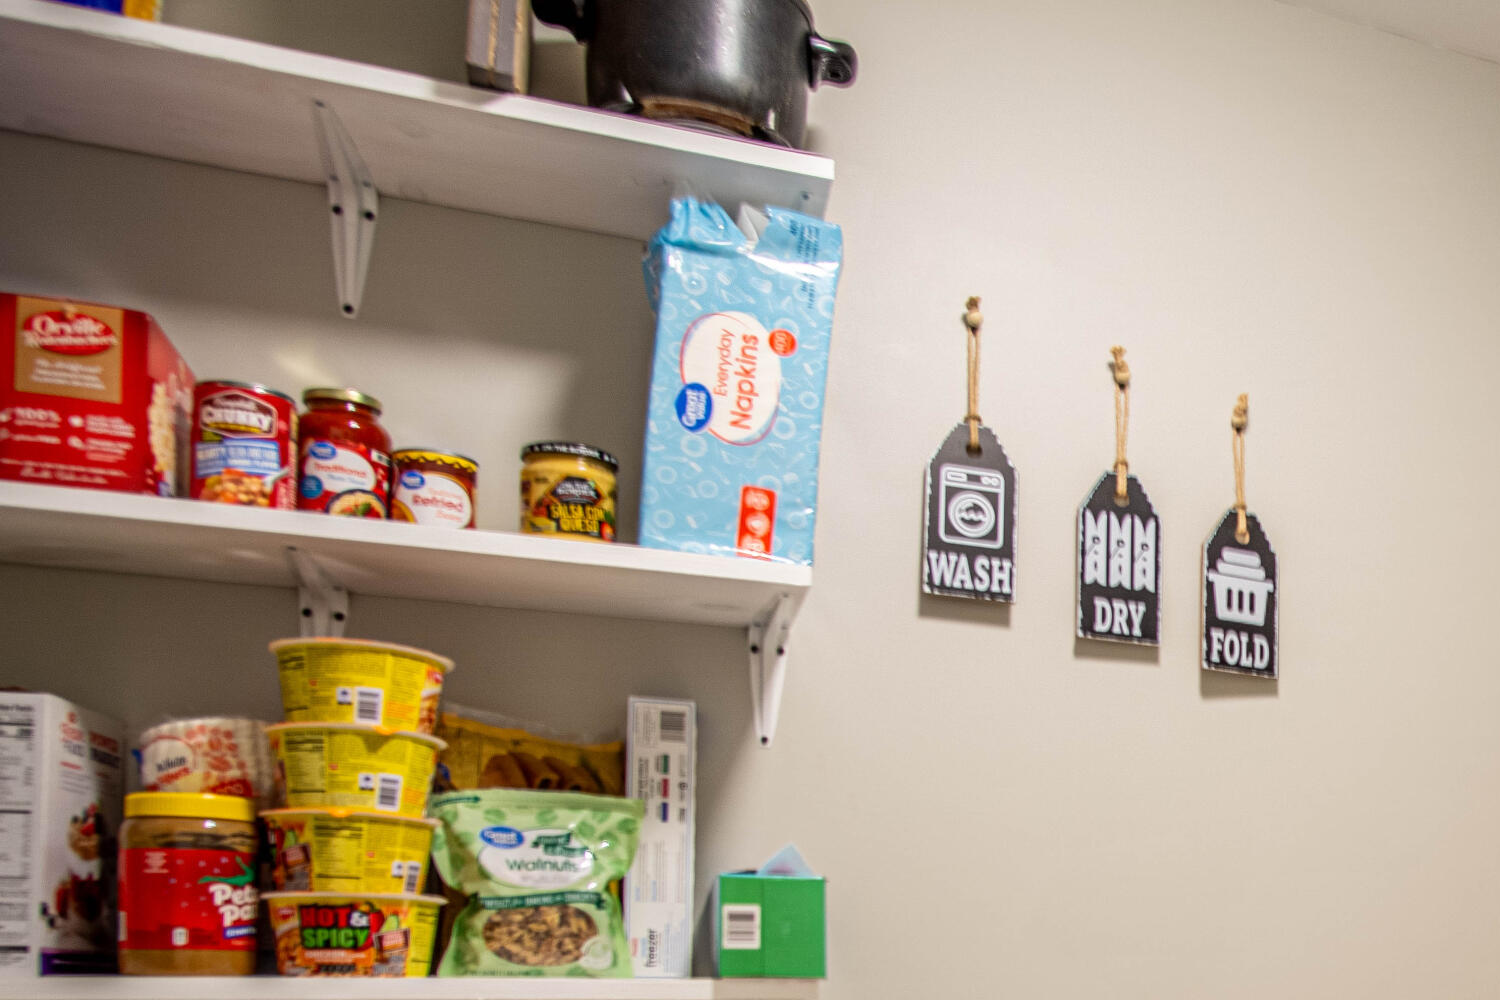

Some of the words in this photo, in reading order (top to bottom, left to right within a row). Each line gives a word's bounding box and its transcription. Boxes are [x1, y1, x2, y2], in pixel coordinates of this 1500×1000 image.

[713, 328, 735, 397] Everyday
[729, 333, 760, 430] Napkins
[682, 389, 698, 427] Great
[927, 549, 1013, 594] WASH
[1093, 597, 1146, 638] DRY
[1210, 627, 1271, 670] FOLD
[505, 859, 580, 873] Walnuts
[303, 908, 350, 927] HOT
[351, 911, 369, 926] &
[303, 928, 369, 948] SPICY
